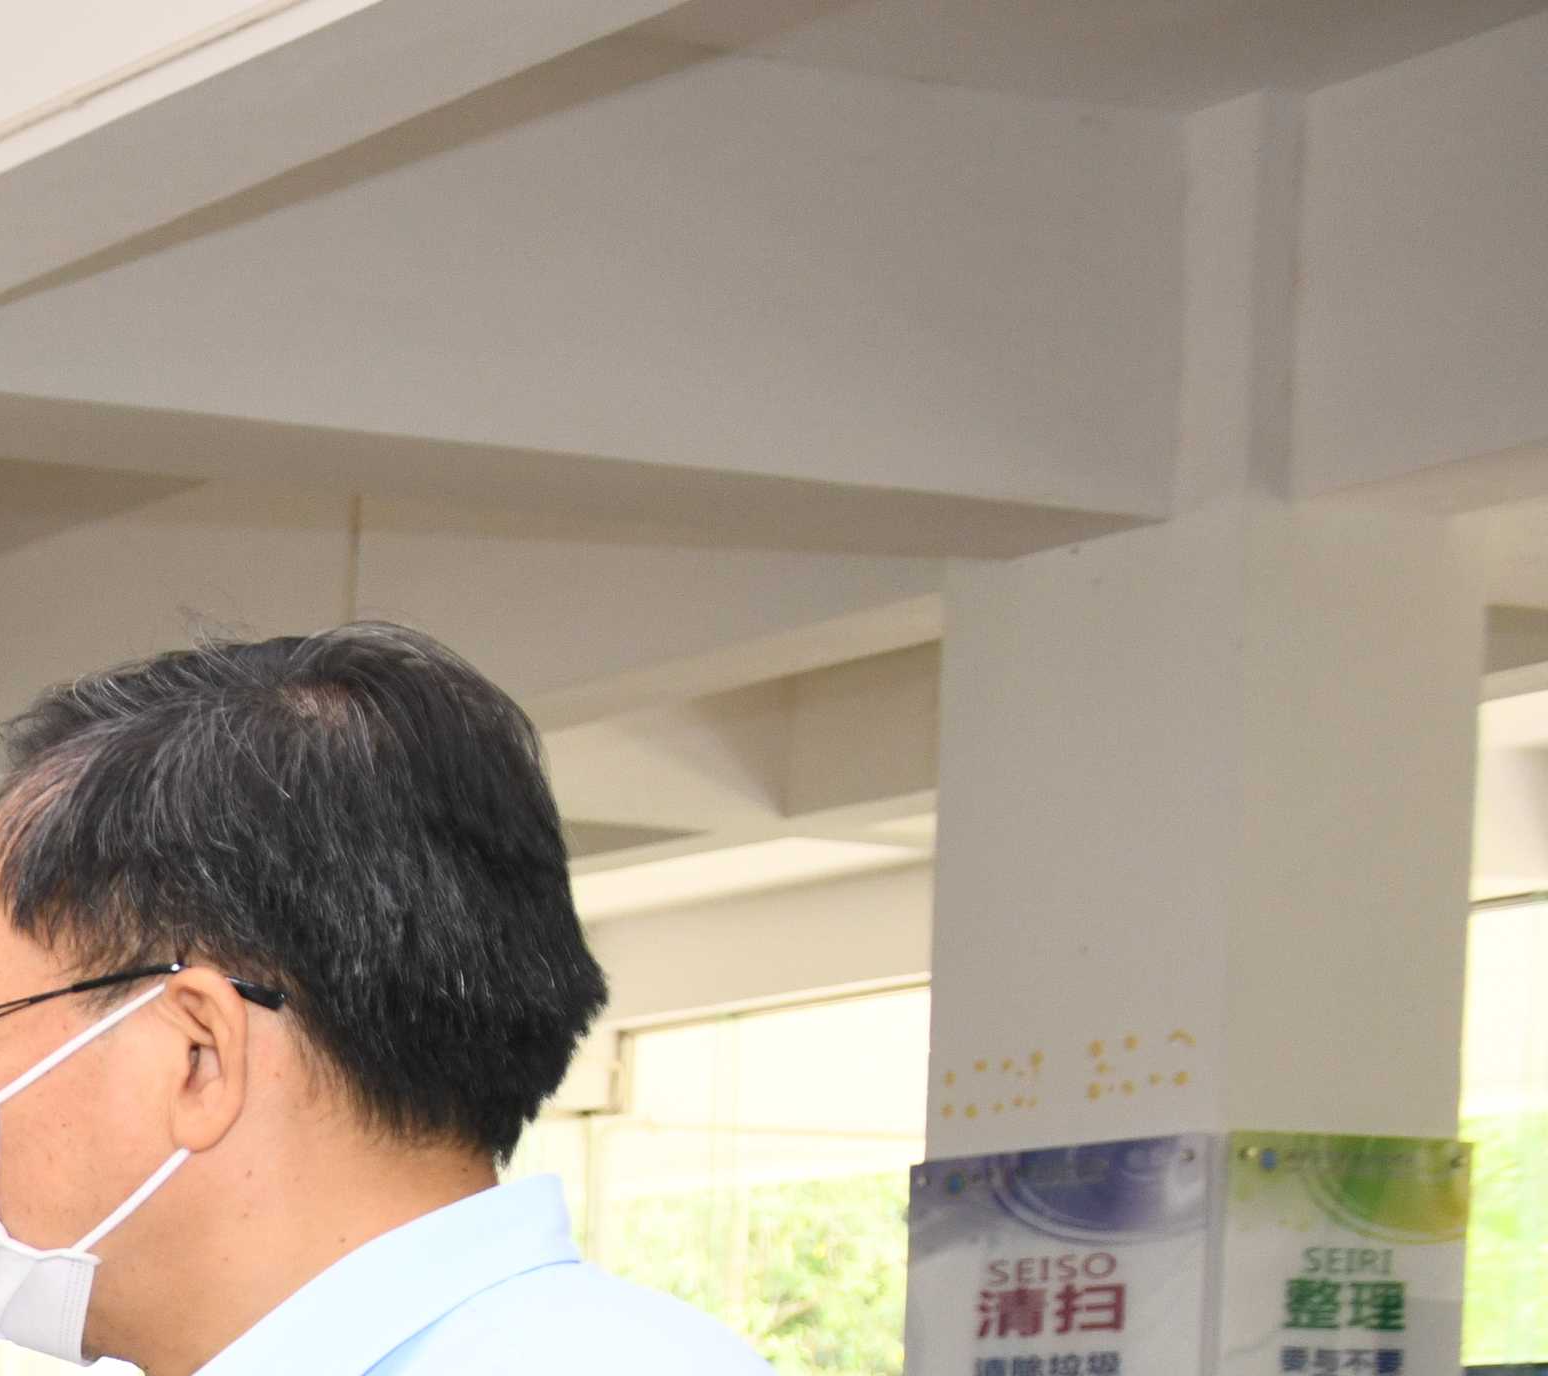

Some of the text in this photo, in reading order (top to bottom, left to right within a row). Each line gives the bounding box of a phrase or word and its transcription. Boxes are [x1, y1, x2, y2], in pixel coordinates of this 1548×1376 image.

[987, 1252, 1118, 1287] SEISO
[1302, 1246, 1395, 1275] SEIRI
[976, 1283, 1127, 1339] 清扫
[1282, 1277, 1406, 1331] 整理
